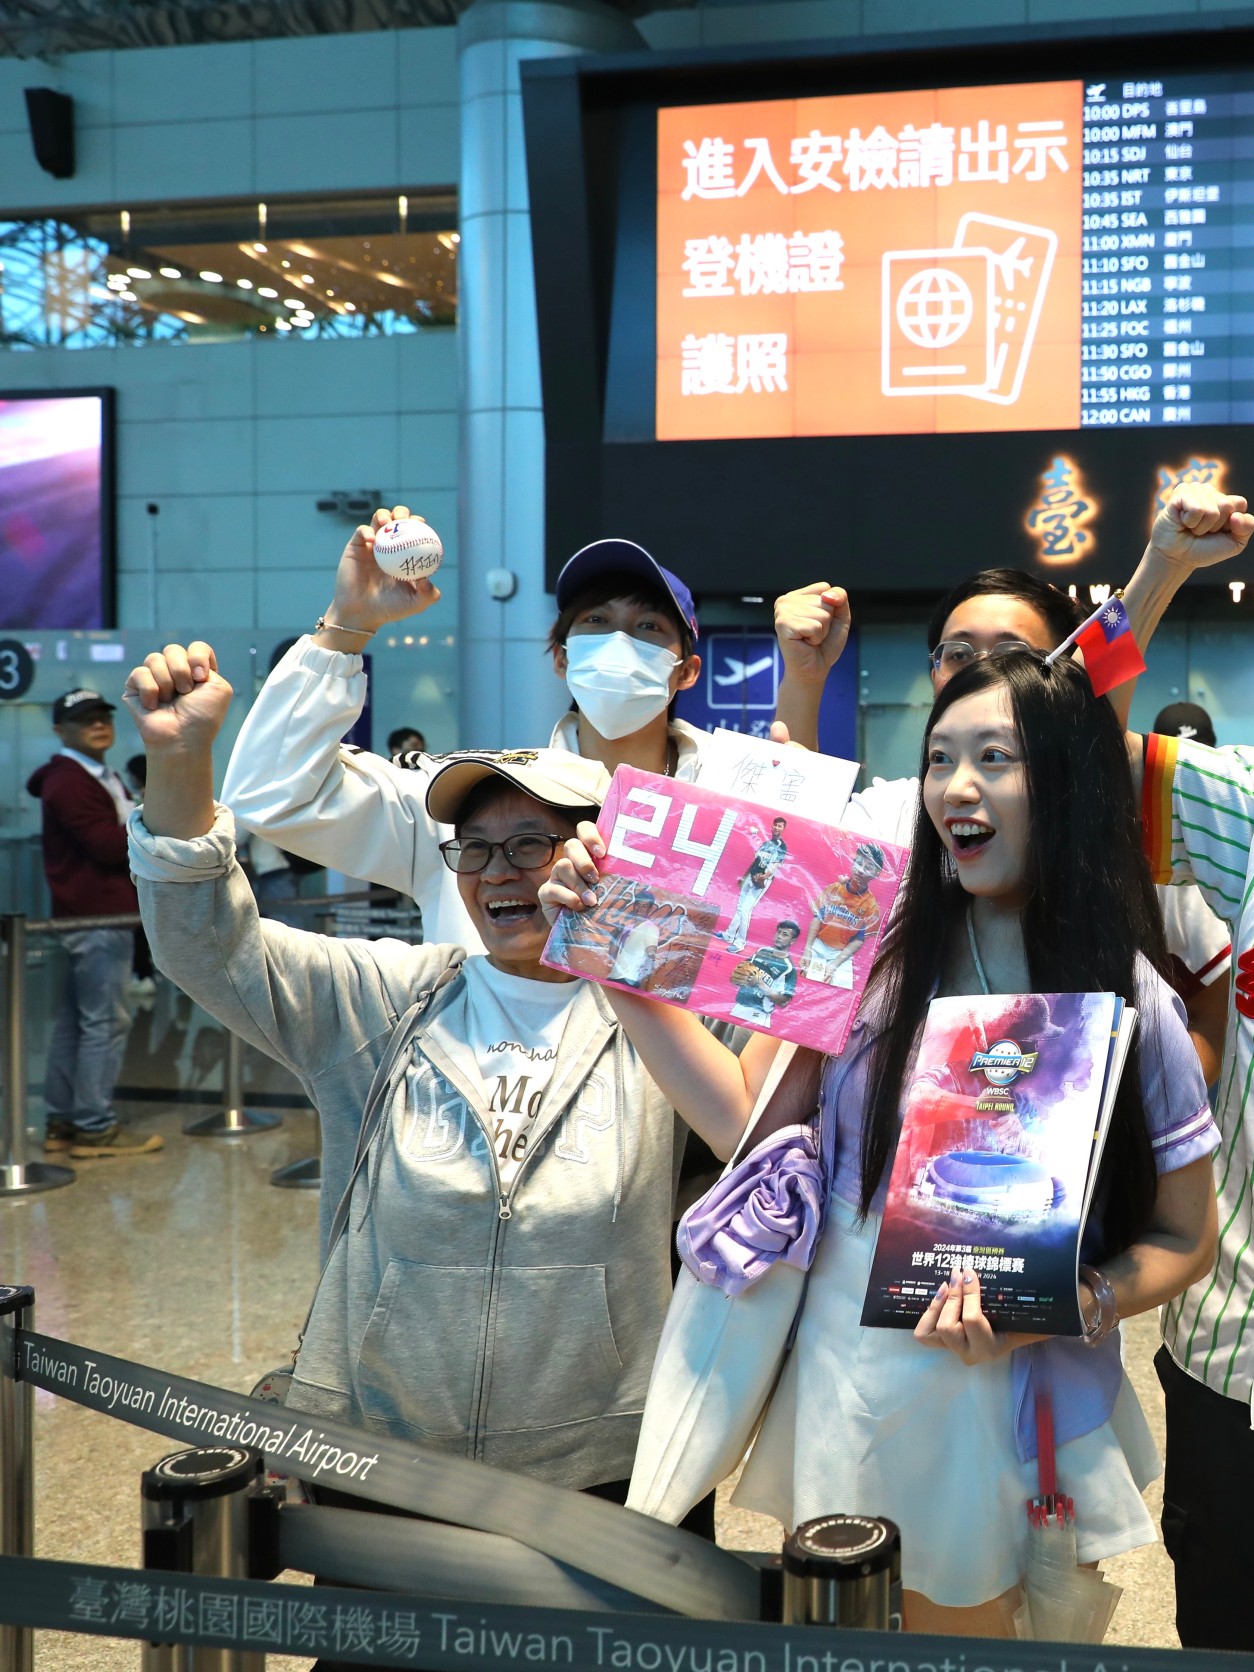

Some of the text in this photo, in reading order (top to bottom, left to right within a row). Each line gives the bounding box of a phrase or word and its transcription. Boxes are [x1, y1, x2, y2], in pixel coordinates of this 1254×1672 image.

[1083, 104, 1150, 120] 10:00 DPS
[680, 120, 1069, 201] 進入安檢請出示
[1083, 147, 1146, 163] 10:15 SDJ
[1083, 190, 1143, 207] 10:35 IST
[1082, 233, 1155, 250] 11:00 XMN
[681, 230, 845, 298] 登機證
[1082, 277, 1152, 294] 11:15 NGB
[1082, 320, 1149, 337] 11:25 FOC
[680, 333, 788, 396] 護照
[1081, 363, 1152, 380] 11:50 CGO
[1081, 407, 1151, 424] 12:00 CAN
[0, 650, 20, 690] 3
[606, 786, 739, 897] 24
[986, 1087, 1009, 1095] WBSC
[976, 1101, 993, 1111] TAIPEI
[911, 1251, 1025, 1274] 世界12強棒球錦標賽
[983, 1272, 997, 1280] 2024
[24, 1341, 77, 1386] Taiwan
[84, 1360, 156, 1412] Taoyuan
[157, 1386, 296, 1455] International
[286, 1429, 378, 1481] Airport
[68, 1576, 421, 1659] 臺灣桃園國際機場
[432, 1612, 574, 1664] Taiwan
[587, 1627, 767, 1672] Taoyuan
